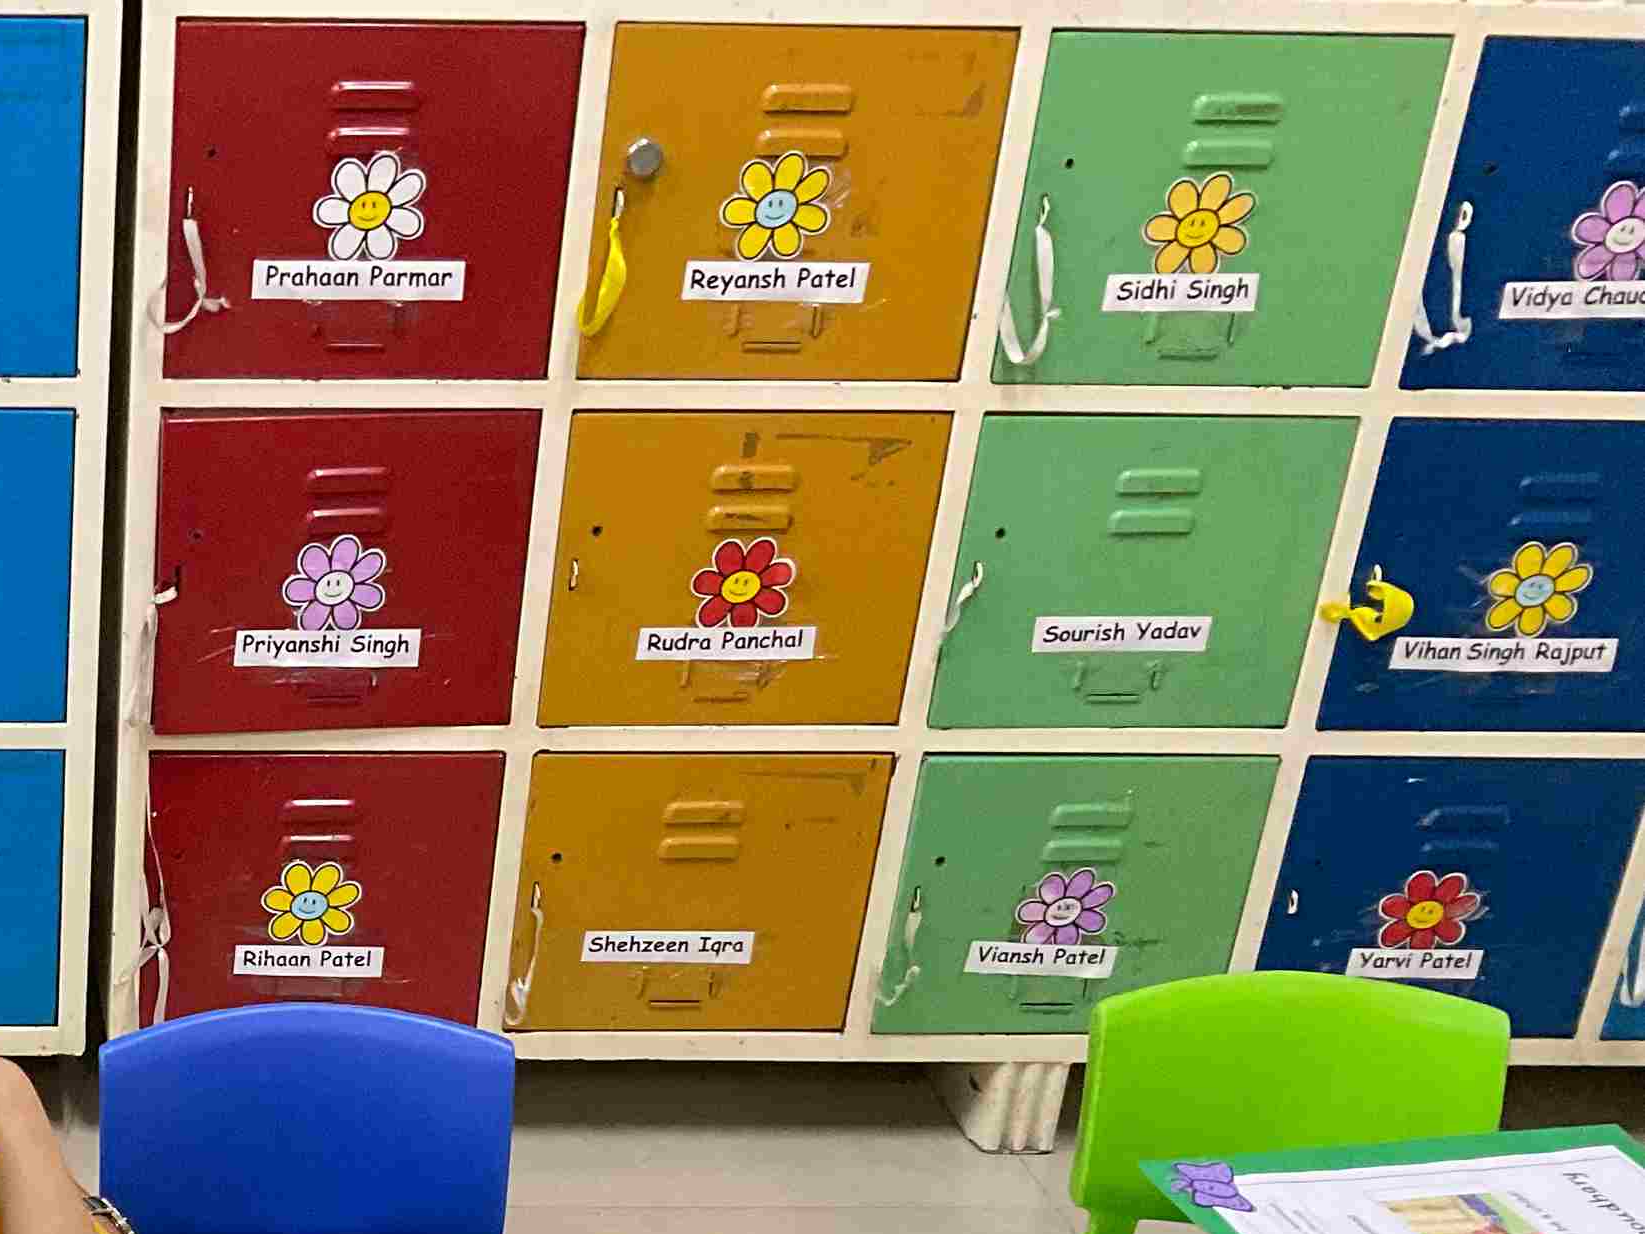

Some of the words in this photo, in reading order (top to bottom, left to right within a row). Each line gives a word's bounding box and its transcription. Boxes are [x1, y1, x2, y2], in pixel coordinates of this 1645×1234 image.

[266, 266, 359, 287] Prahaan
[370, 266, 453, 287] Parmar
[690, 267, 785, 295] Reyansh
[795, 266, 856, 288] Patel
[1115, 279, 1175, 300] Sidhi
[1186, 279, 1249, 305] Singh
[1512, 286, 1572, 312] Vidya
[647, 632, 711, 652] Rudra
[722, 630, 803, 651] Panchal
[1042, 623, 1125, 643] Sourish
[1137, 622, 1202, 640] Yadav
[242, 634, 340, 657] Priyanshi
[350, 634, 410, 658] Singh
[1404, 642, 1461, 661] Vihan
[1468, 642, 1525, 662] Singh
[1534, 644, 1608, 666] Rajput
[243, 950, 311, 967] Rihaan
[320, 951, 372, 968] Patel
[588, 938, 689, 954] Shehzeen
[698, 938, 744, 959] Iqra
[978, 946, 1044, 965] Viansh
[1055, 949, 1106, 965] Patel
[1360, 952, 1413, 969] Yarvi
[1420, 952, 1473, 970] Patel
